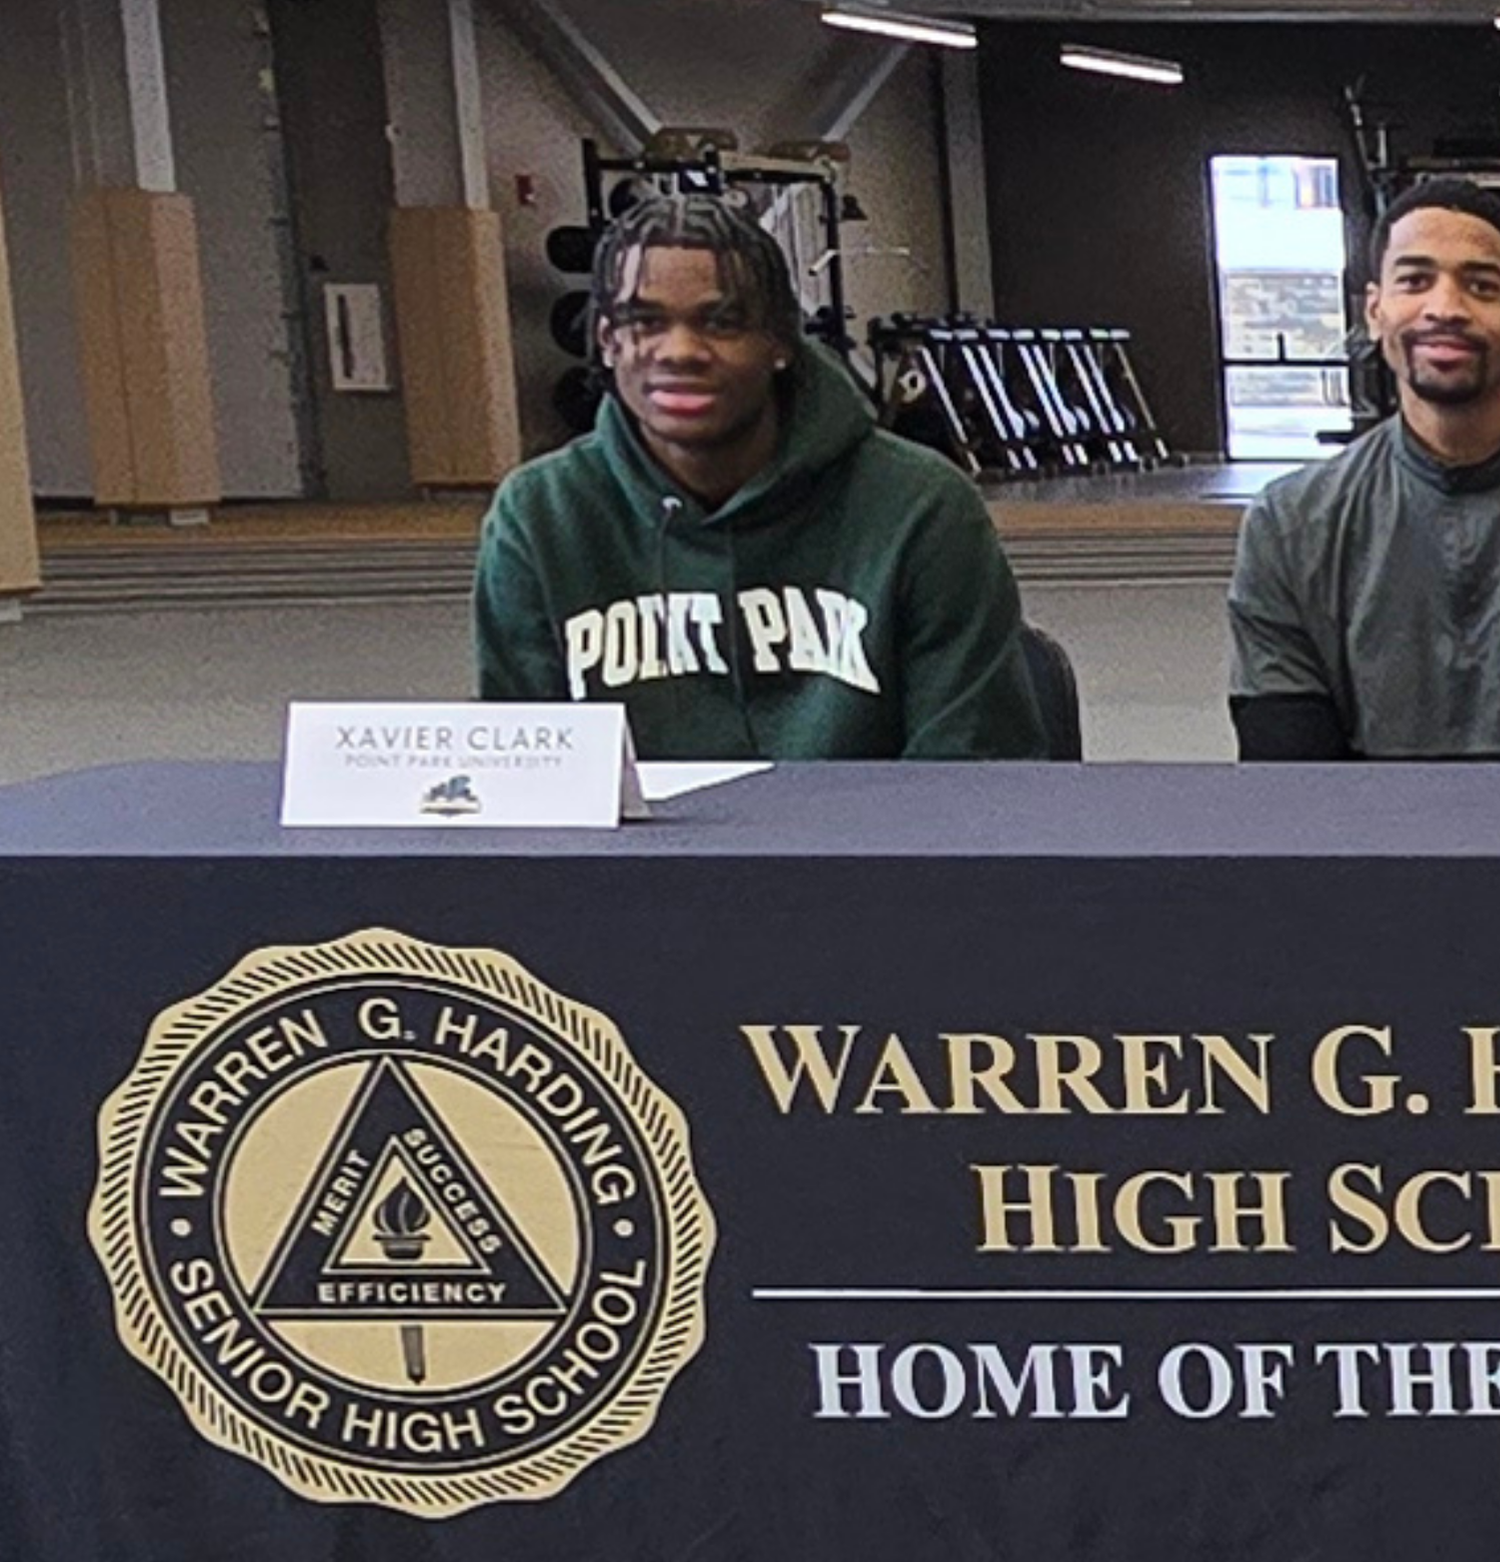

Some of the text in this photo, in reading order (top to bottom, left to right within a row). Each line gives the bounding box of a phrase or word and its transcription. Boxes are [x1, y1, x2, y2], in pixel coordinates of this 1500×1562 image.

[335, 725, 574, 751] XAVIER CLARK
[160, 998, 637, 1205] WARREN G. HARDING
[739, 1025, 1275, 1114] WARREN
[1312, 1025, 1429, 1116] G.
[311, 1150, 371, 1236] MERIT
[402, 1127, 502, 1254] SUCCESS
[969, 1164, 1295, 1253] HIGH
[317, 1282, 506, 1303] EFFICIENCY
[170, 1259, 648, 1453] SENIOR HIGH SCHOOL
[808, 1343, 1130, 1419] HOME
[1158, 1343, 1294, 1418] OF
